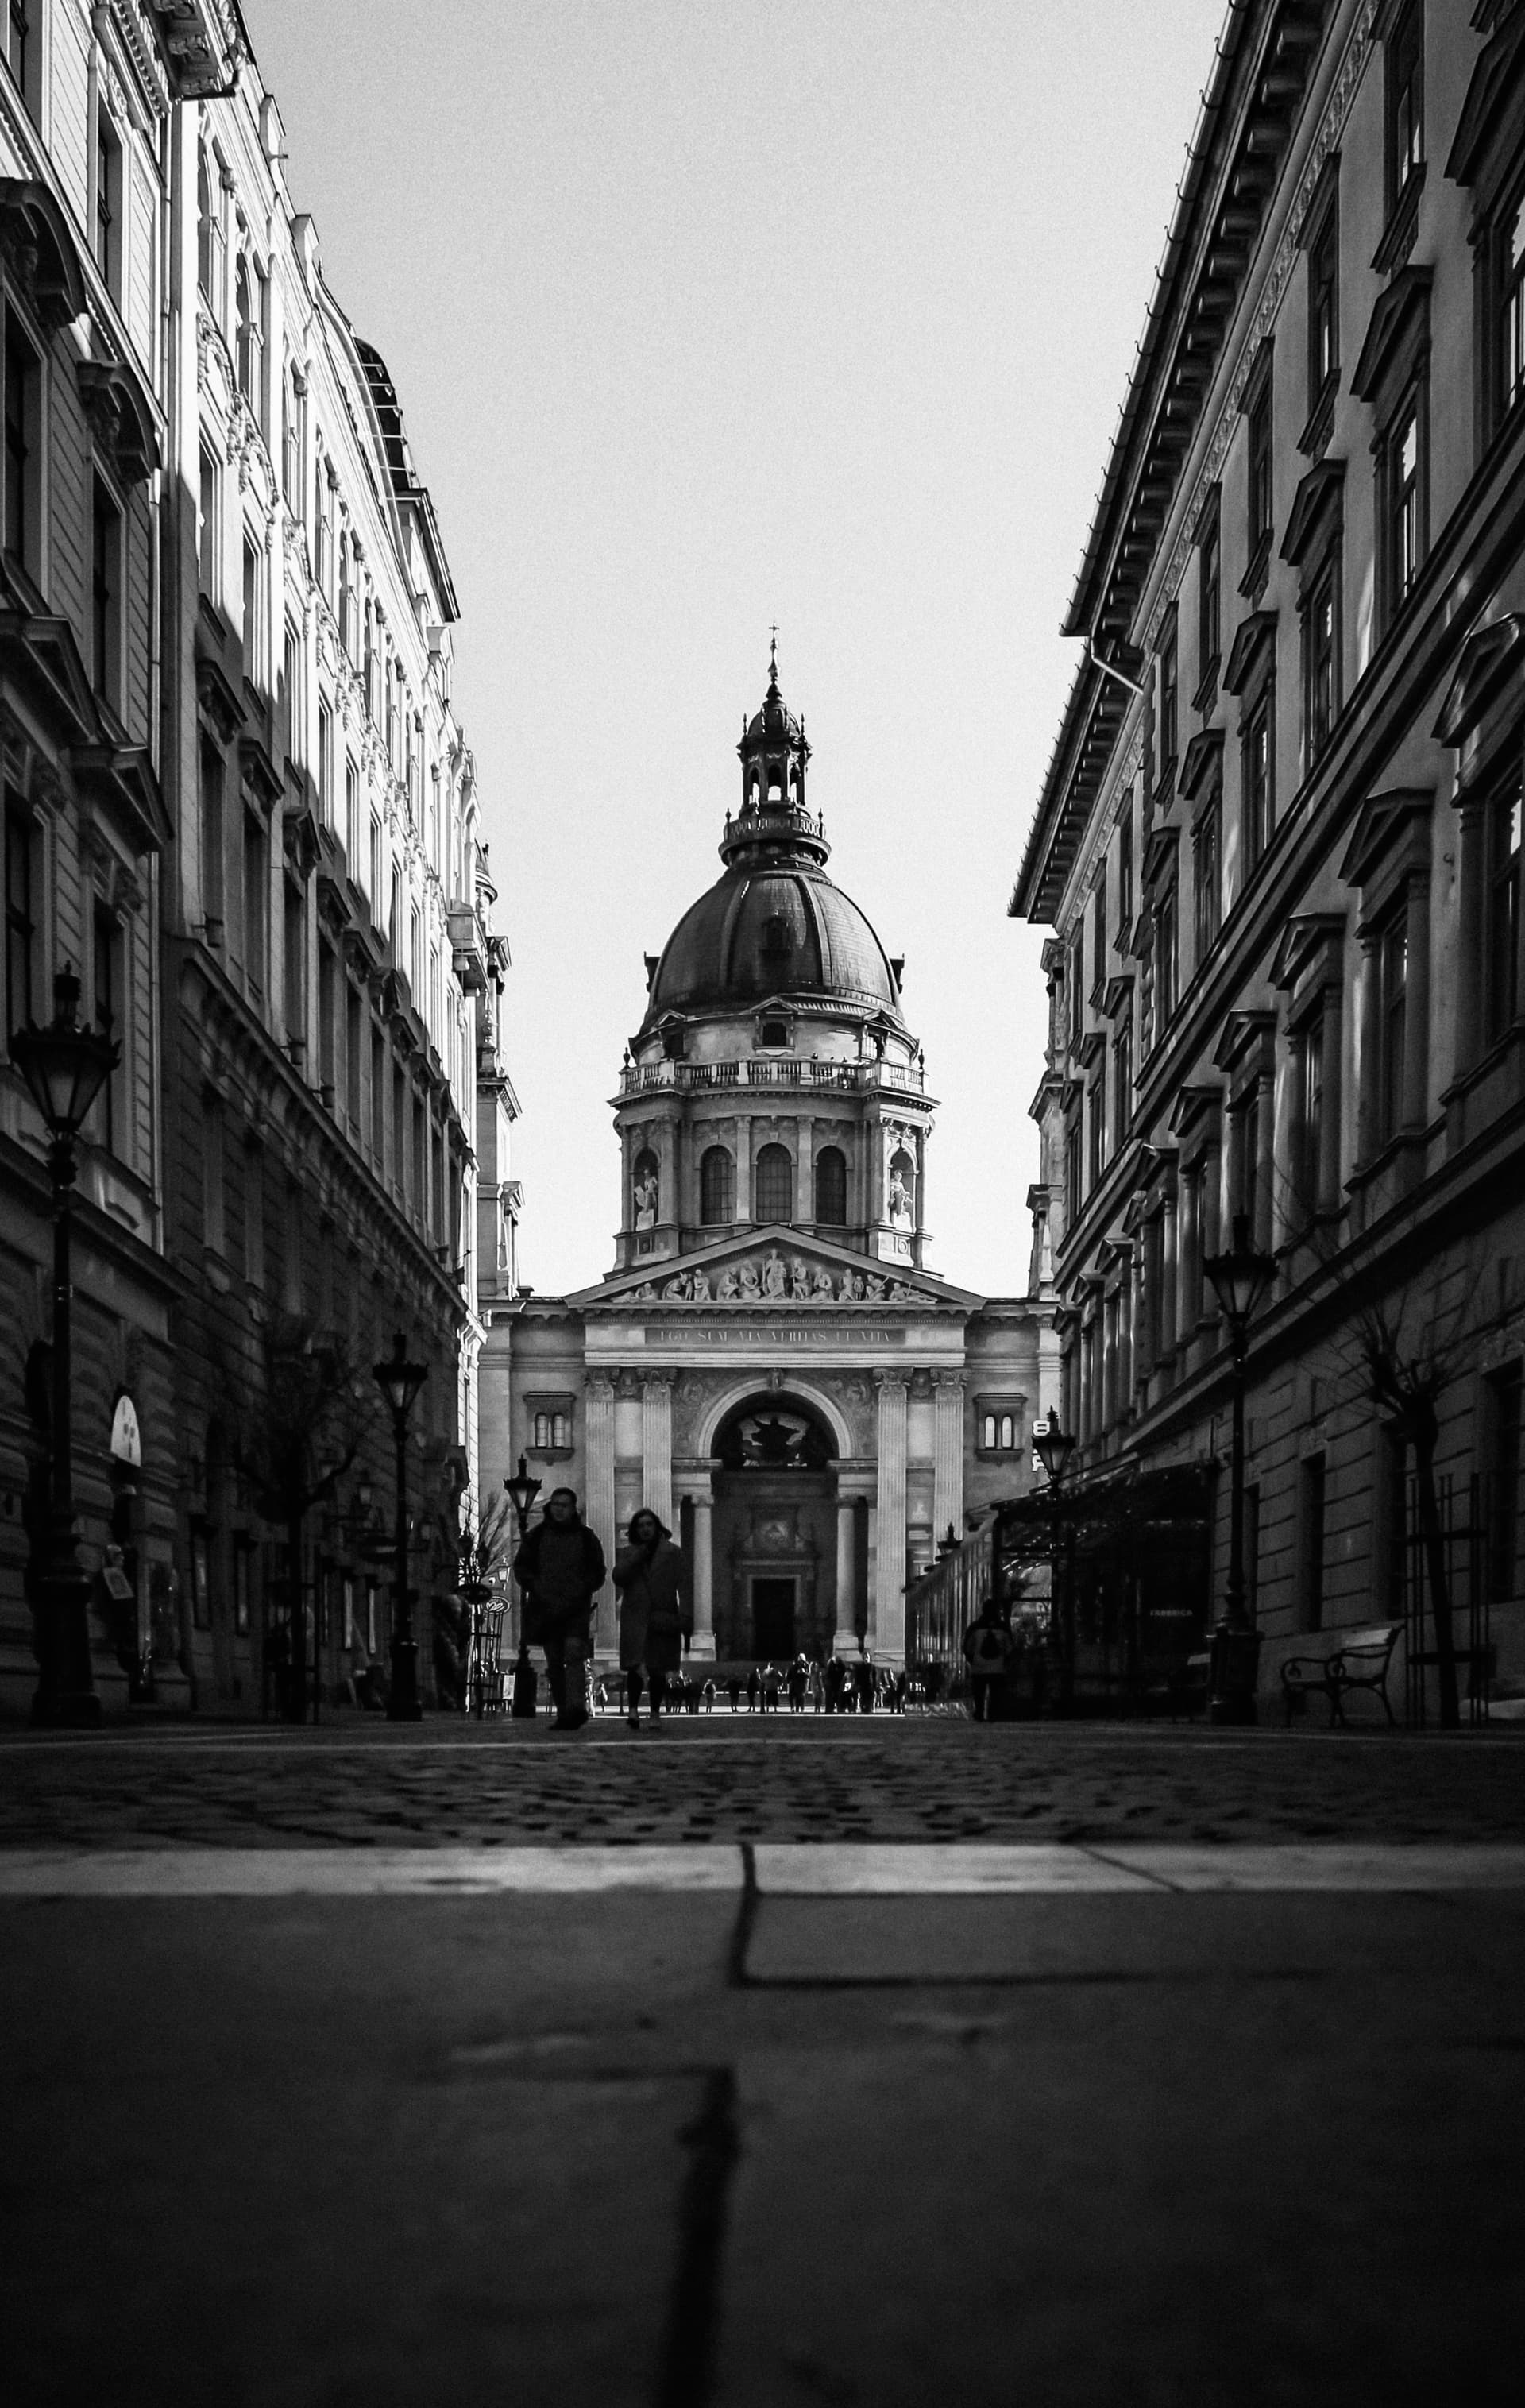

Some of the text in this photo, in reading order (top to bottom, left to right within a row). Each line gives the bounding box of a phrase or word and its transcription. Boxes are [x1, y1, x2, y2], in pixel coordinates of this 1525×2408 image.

[697, 1331, 727, 1341] SUM
[739, 1331, 762, 1341] VIA
[771, 1331, 827, 1341] VERITAS
[860, 1331, 890, 1341] VITA
